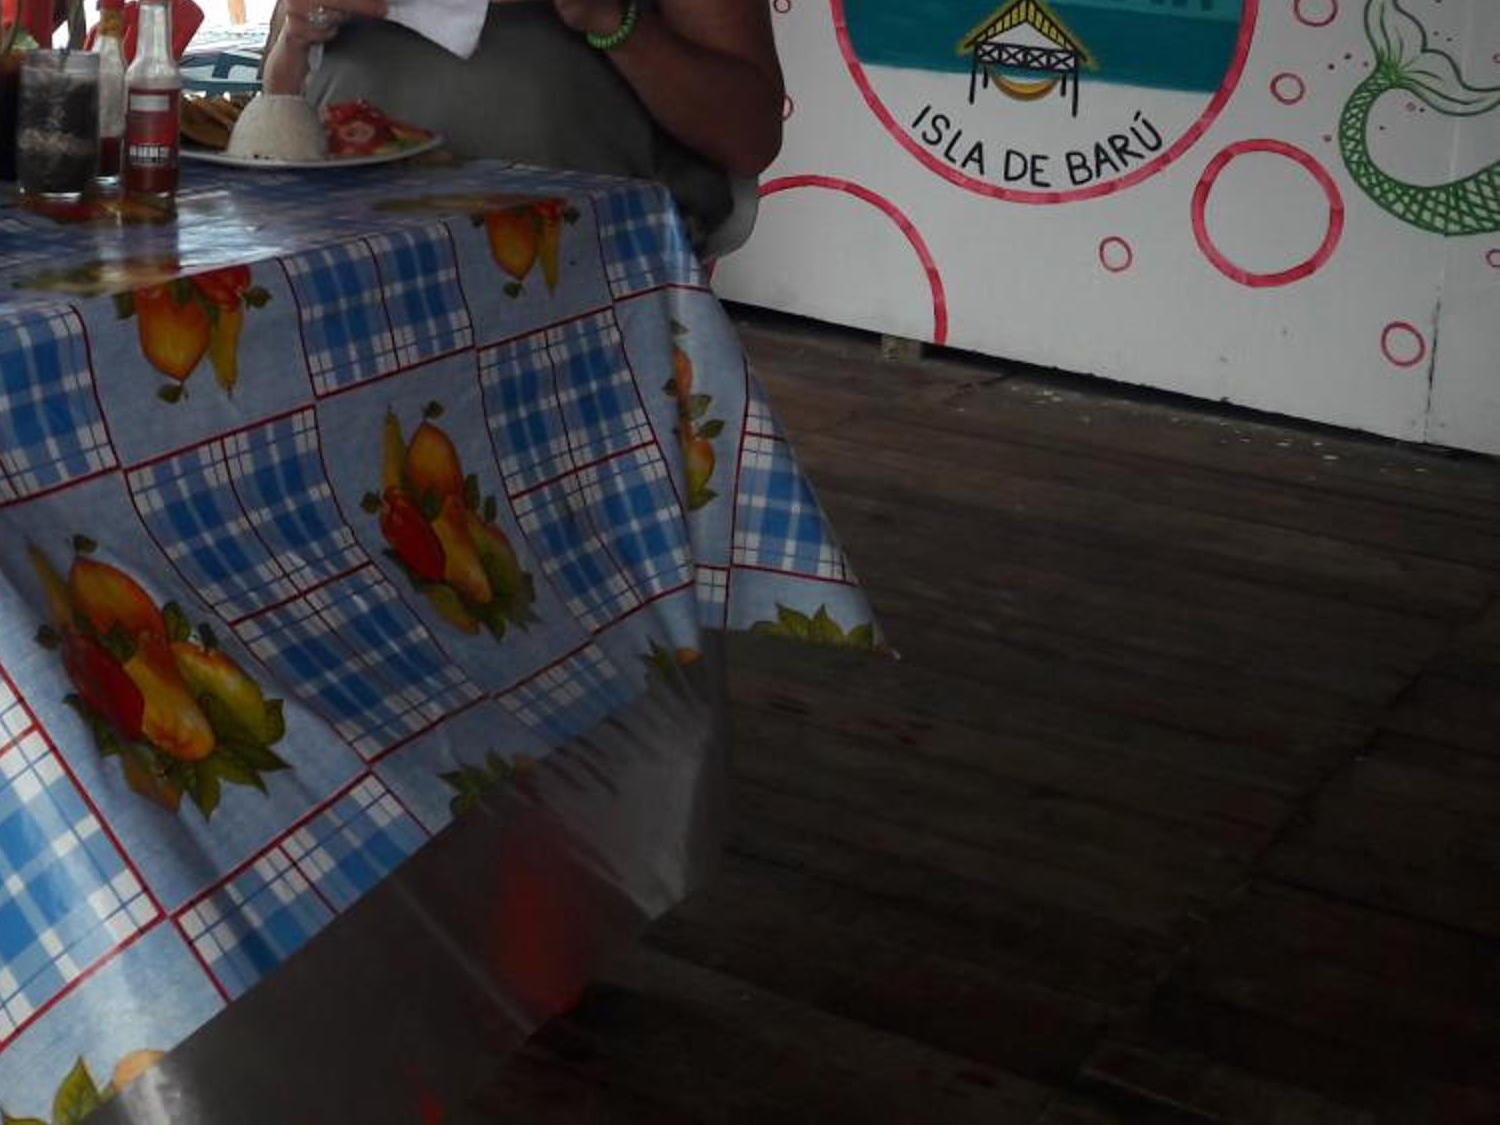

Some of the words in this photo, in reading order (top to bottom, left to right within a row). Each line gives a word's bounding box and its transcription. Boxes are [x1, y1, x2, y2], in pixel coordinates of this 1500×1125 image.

[912, 105, 985, 175] ISLA
[1003, 149, 1051, 187] DE
[1065, 111, 1164, 186] BARÚ
